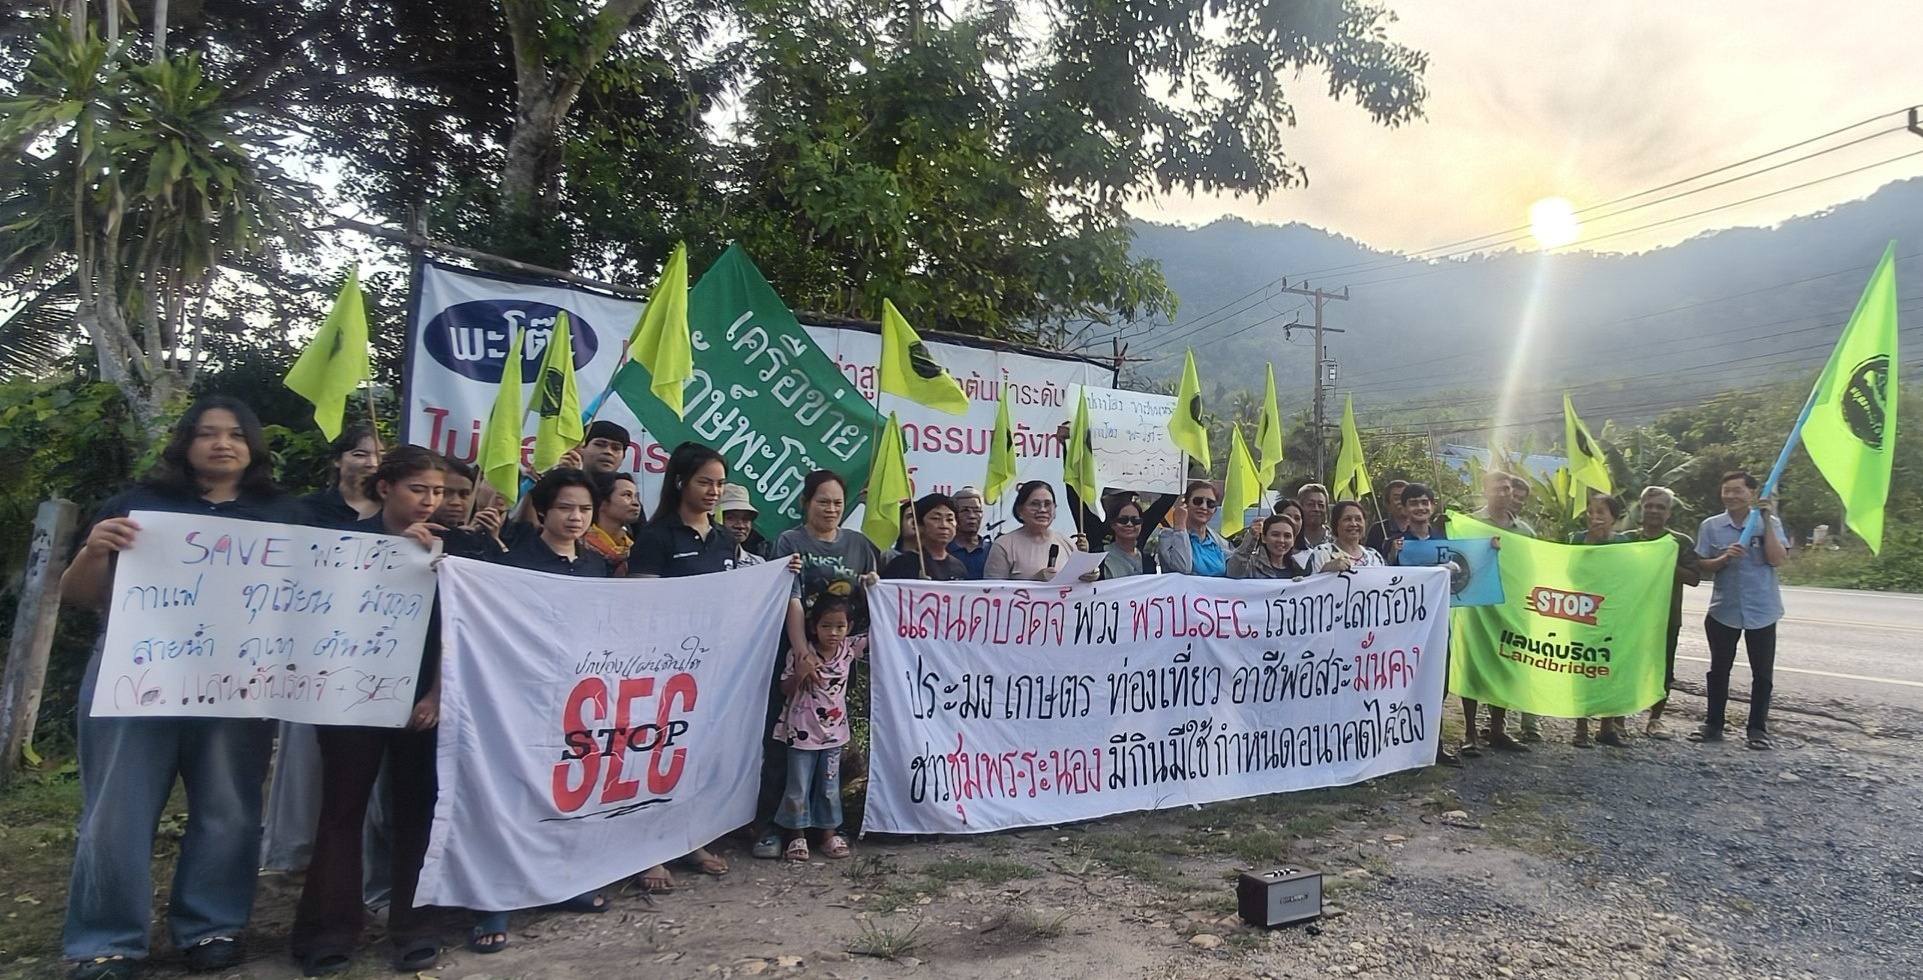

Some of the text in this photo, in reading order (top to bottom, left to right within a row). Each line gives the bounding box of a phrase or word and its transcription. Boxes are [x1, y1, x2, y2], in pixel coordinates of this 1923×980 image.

[726, 310, 868, 462] เครือข่าย
[182, 531, 293, 568] SAVE
[122, 573, 203, 611] กาแฟ
[242, 578, 332, 624] ทุเรียน
[1074, 588, 1120, 645] พ่วง
[1536, 590, 1595, 617] STOP
[133, 623, 215, 665] สายน้ำ
[313, 626, 398, 658] ต้นน้ำ
[1498, 643, 1610, 679] Landbridge
[1499, 630, 1613, 662] แลนด์บริดจ์
[344, 669, 412, 712] SEC
[906, 655, 994, 720] ประมง
[1005, 673, 1096, 720] เกษตร
[1107, 643, 1222, 715] ท่องเที่ยว
[551, 672, 698, 813] SEC
[561, 720, 689, 761] STOP
